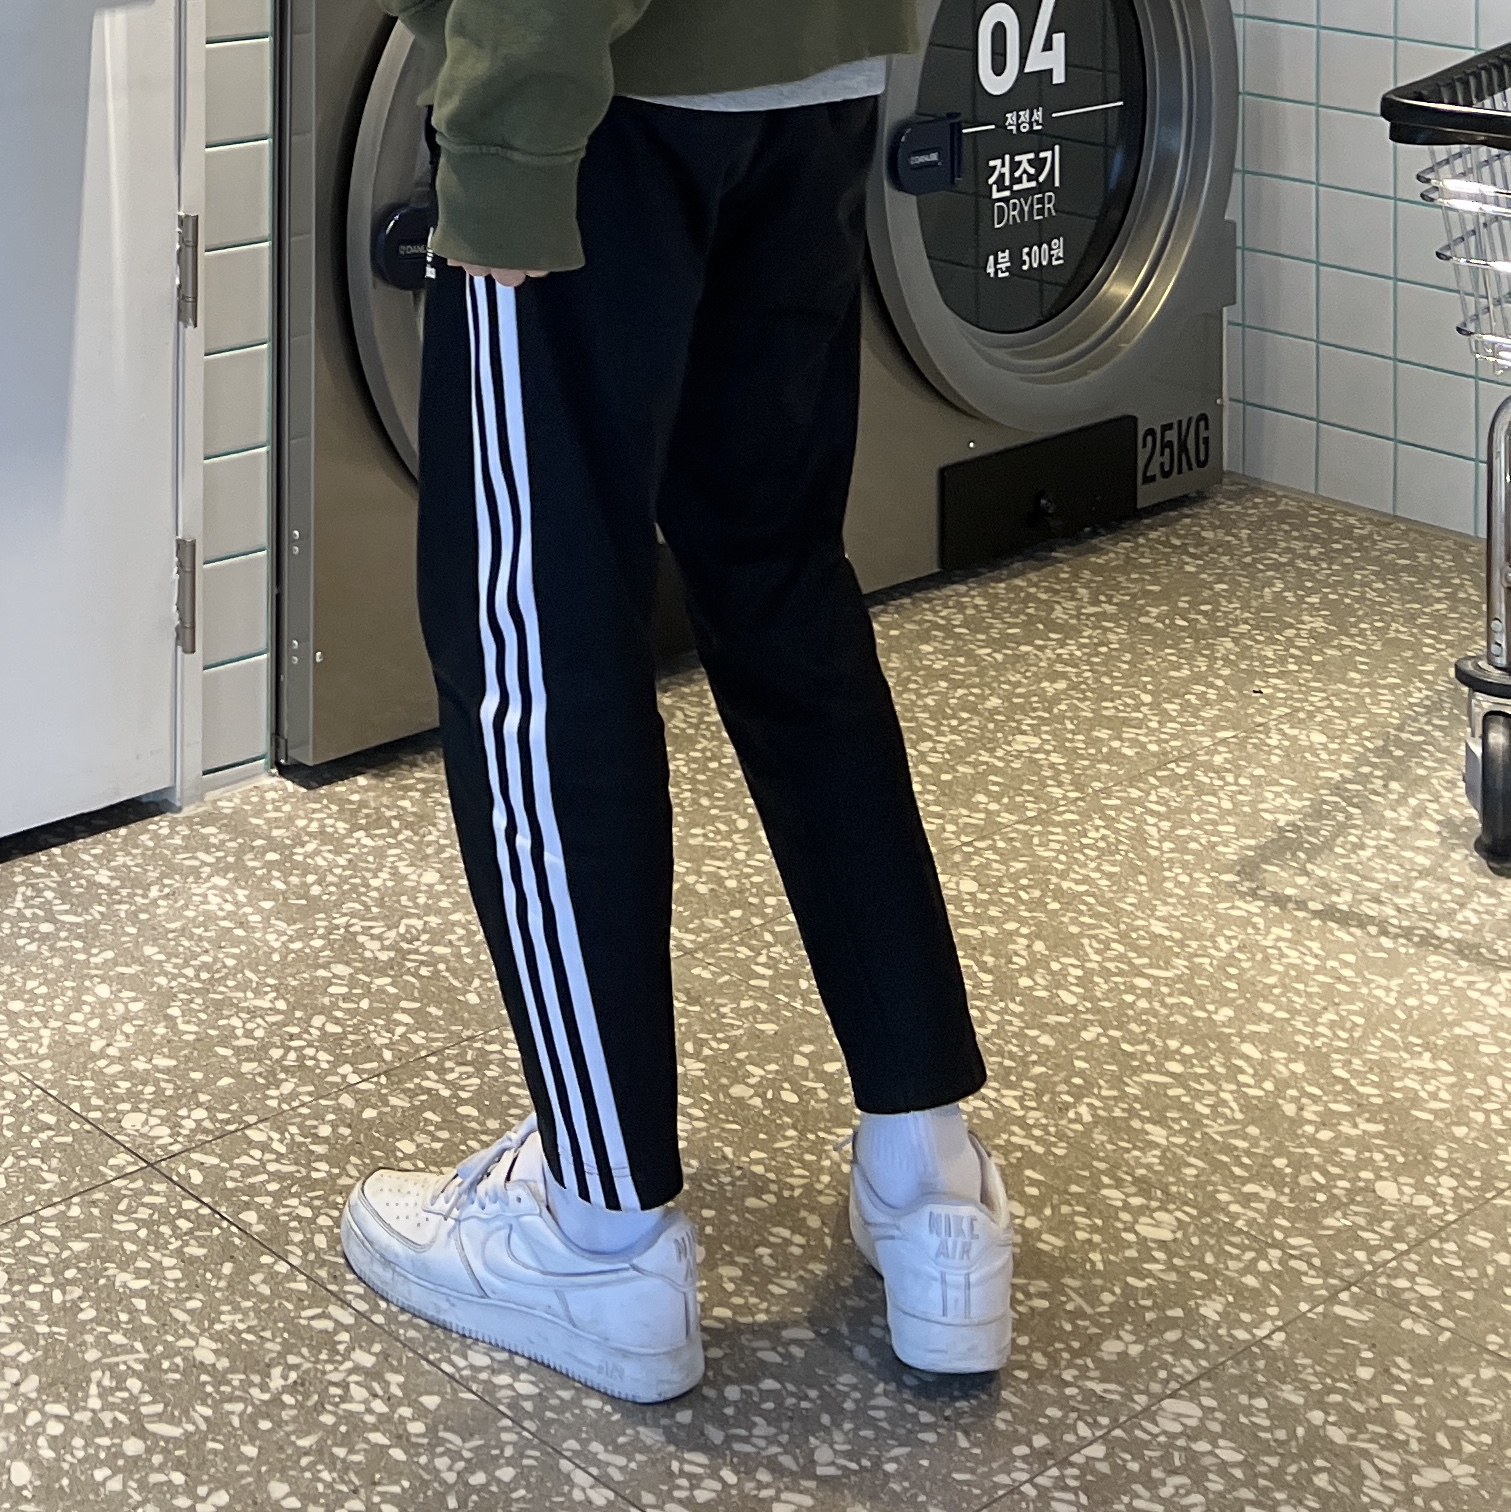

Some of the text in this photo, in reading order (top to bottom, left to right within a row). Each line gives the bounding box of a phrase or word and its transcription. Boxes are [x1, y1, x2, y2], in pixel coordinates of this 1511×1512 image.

[1005, 107, 1043, 134] 적정선
[988, 145, 1060, 199] 건조기
[994, 191, 1056, 229] DRYER
[986, 237, 1064, 278] 4분 500원
[1142, 412, 1210, 485] 25KG
[928, 1210, 980, 1241] NIKE
[935, 1239, 974, 1262] AIR
